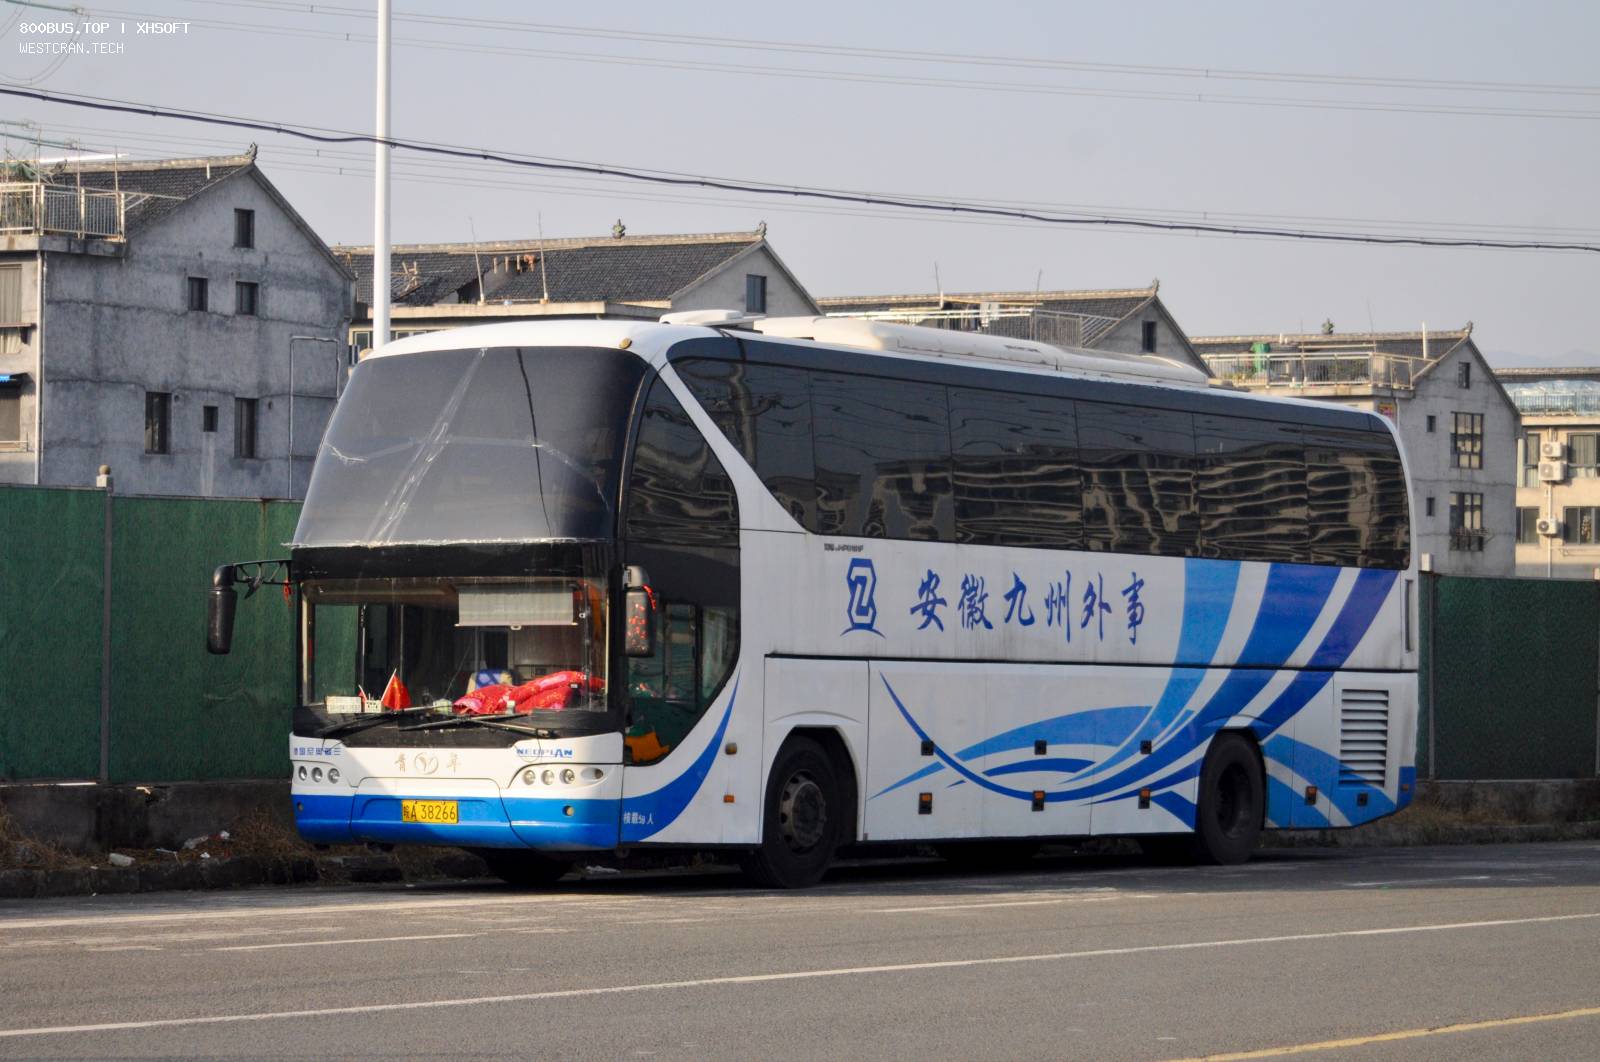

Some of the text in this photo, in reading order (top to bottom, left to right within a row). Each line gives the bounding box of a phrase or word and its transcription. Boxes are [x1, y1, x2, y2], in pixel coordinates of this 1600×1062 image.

[910, 567, 1146, 646] 安徽九州外事
